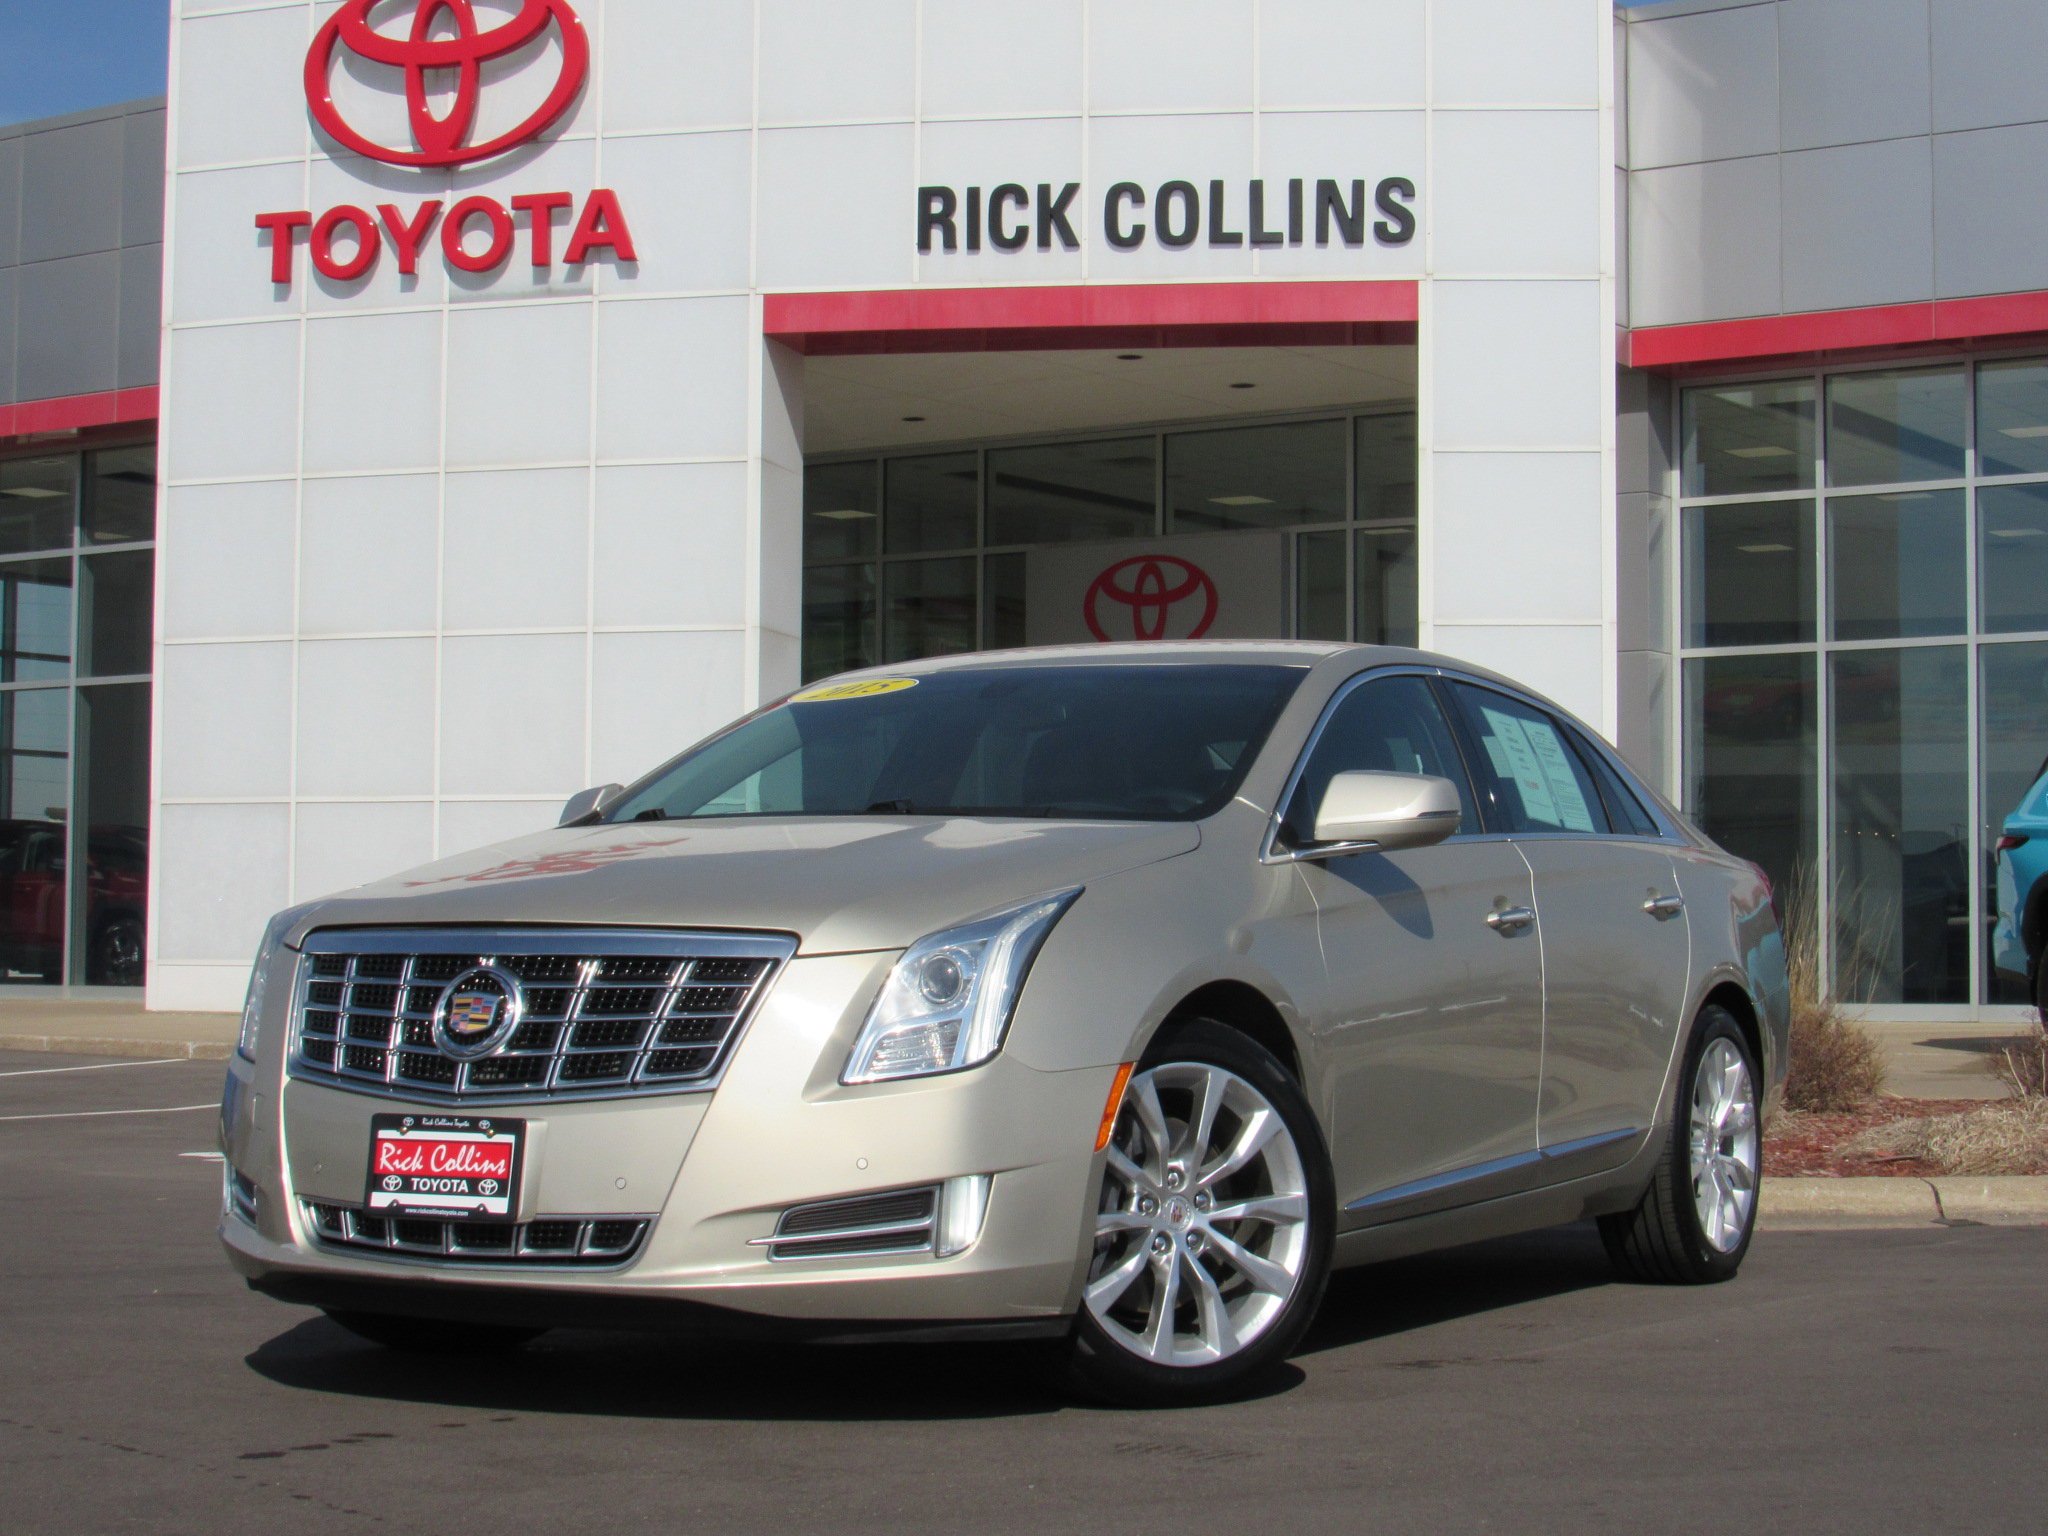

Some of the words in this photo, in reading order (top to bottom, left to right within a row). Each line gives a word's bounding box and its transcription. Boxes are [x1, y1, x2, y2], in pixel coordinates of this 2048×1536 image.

[255, 188, 639, 284] TOYOTA
[917, 182, 1081, 251] RICK
[1103, 177, 1416, 248] COLLINS
[380, 1143, 423, 1172] Rick
[431, 1145, 506, 1174] Collins
[411, 1178, 468, 1192] TOYOTA
